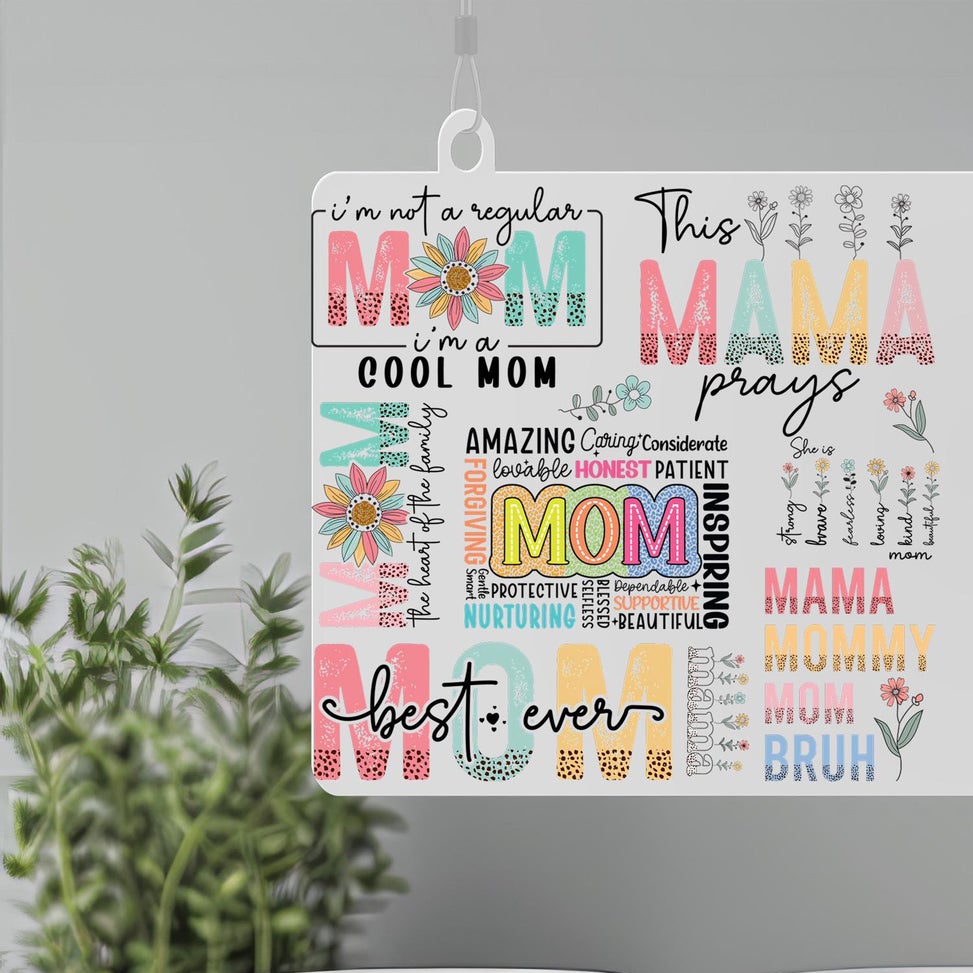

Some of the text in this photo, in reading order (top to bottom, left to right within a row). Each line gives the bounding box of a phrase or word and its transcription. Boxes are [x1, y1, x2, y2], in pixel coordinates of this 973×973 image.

[331, 185, 583, 247] i'm not a regular
[634, 186, 741, 254] This
[639, 258, 936, 367] MAMA
[412, 326, 501, 352] i'm a
[357, 355, 557, 389] COOL MOM
[692, 366, 861, 438] prays
[465, 427, 728, 457] AMAZING Caring Considerate
[790, 436, 836, 459] She is
[492, 458, 729, 482] lovable HONEST PATIENT
[406, 401, 448, 628] the heart of the family
[463, 458, 487, 566] FORGIVING
[499, 494, 692, 567] MOM
[776, 500, 808, 546] strong
[805, 503, 828, 546] brave
[840, 494, 859, 546] fearless
[870, 503, 890, 546] loving
[897, 512, 914, 546] kind
[922, 505, 941, 546] beautiful
[702, 482, 730, 630] INSPIRING
[889, 551, 932, 561] mom
[465, 569, 477, 600] Smart
[478, 567, 489, 600] Gentle
[491, 582, 578, 599] PROTECTIVE
[581, 579, 594, 629] SELFLESS
[596, 579, 610, 629] BLESSED
[612, 594, 700, 611] SUPPORTIVE
[613, 579, 690, 593] Dependable
[764, 567, 895, 615] MAMA
[463, 603, 576, 630] NURTURING
[618, 612, 703, 630] BEAUTIFUL
[764, 623, 936, 673] MOMMY
[313, 641, 674, 782] MOM
[322, 661, 665, 762] best ever
[764, 682, 854, 725] MOM
[764, 733, 875, 782] BRUH
